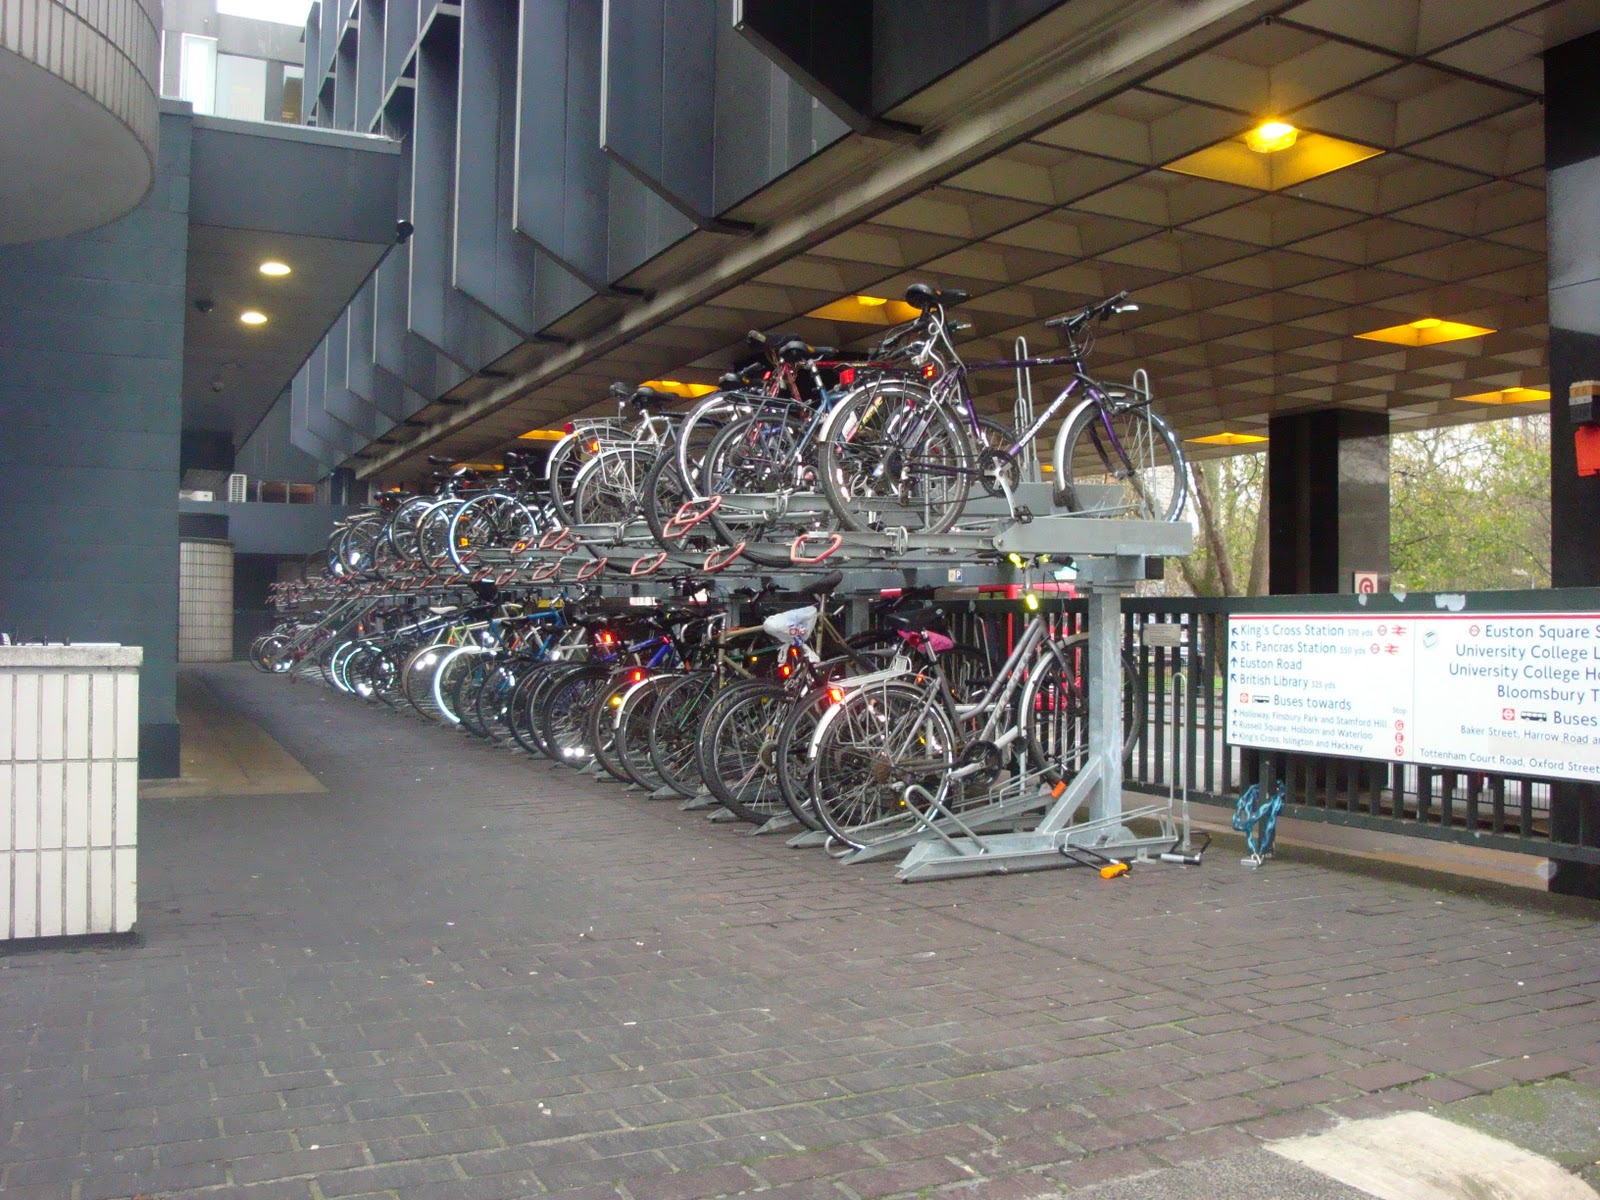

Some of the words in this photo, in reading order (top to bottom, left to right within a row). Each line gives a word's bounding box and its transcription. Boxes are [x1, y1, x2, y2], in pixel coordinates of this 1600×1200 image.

[1240, 624, 1270, 638] King's
[1272, 624, 1302, 636] Cross
[1305, 624, 1344, 636] Station
[1347, 628, 1360, 637] 570
[1361, 629, 1373, 638] yds
[1485, 624, 1534, 638] Euston
[1538, 624, 1590, 641] Square
[1240, 640, 1253, 651] St.
[1256, 641, 1294, 653] Pancras
[1297, 641, 1337, 654] Station
[1340, 645, 1352, 654] 550
[1353, 647, 1366, 656] yds
[1456, 644, 1526, 661] University
[1530, 644, 1588, 662] College
[1240, 657, 1273, 669] Euston
[1277, 658, 1302, 670] Road
[1449, 663, 1519, 681] University
[1523, 665, 1580, 683] College
[1240, 674, 1271, 686] British
[1273, 674, 1309, 690] Library
[1324, 681, 1336, 690] yds
[1273, 694, 1304, 707] Buses
[1307, 697, 1352, 710] towards
[1497, 684, 1585, 705] Bloomsbury
[1392, 706, 1407, 715] Stop
[1553, 710, 1598, 727] Buses
[1272, 711, 1301, 723] Finsbury
[1303, 713, 1319, 723] Park
[1320, 715, 1335, 724] and
[1337, 715, 1371, 728] Stamford
[1374, 719, 1388, 728] Hill
[1239, 720, 1262, 730] Russell
[1291, 724, 1320, 735] Holborn
[1321, 728, 1335, 737] and
[1337, 727, 1373, 740] Waterloo
[1460, 725, 1485, 736] Baker
[1488, 727, 1521, 739] Street,
[1523, 730, 1560, 742] Harrow
[1563, 732, 1589, 744] Road
[1239, 732, 1259, 743] King's
[1282, 736, 1314, 748] Islington
[1315, 739, 1329, 748] and
[1331, 740, 1364, 752] Hackney
[1420, 748, 1467, 761] Tottenham
[1469, 752, 1496, 765] Court
[1529, 758, 1564, 771] Oxford
[1568, 761, 1600, 774] Street
